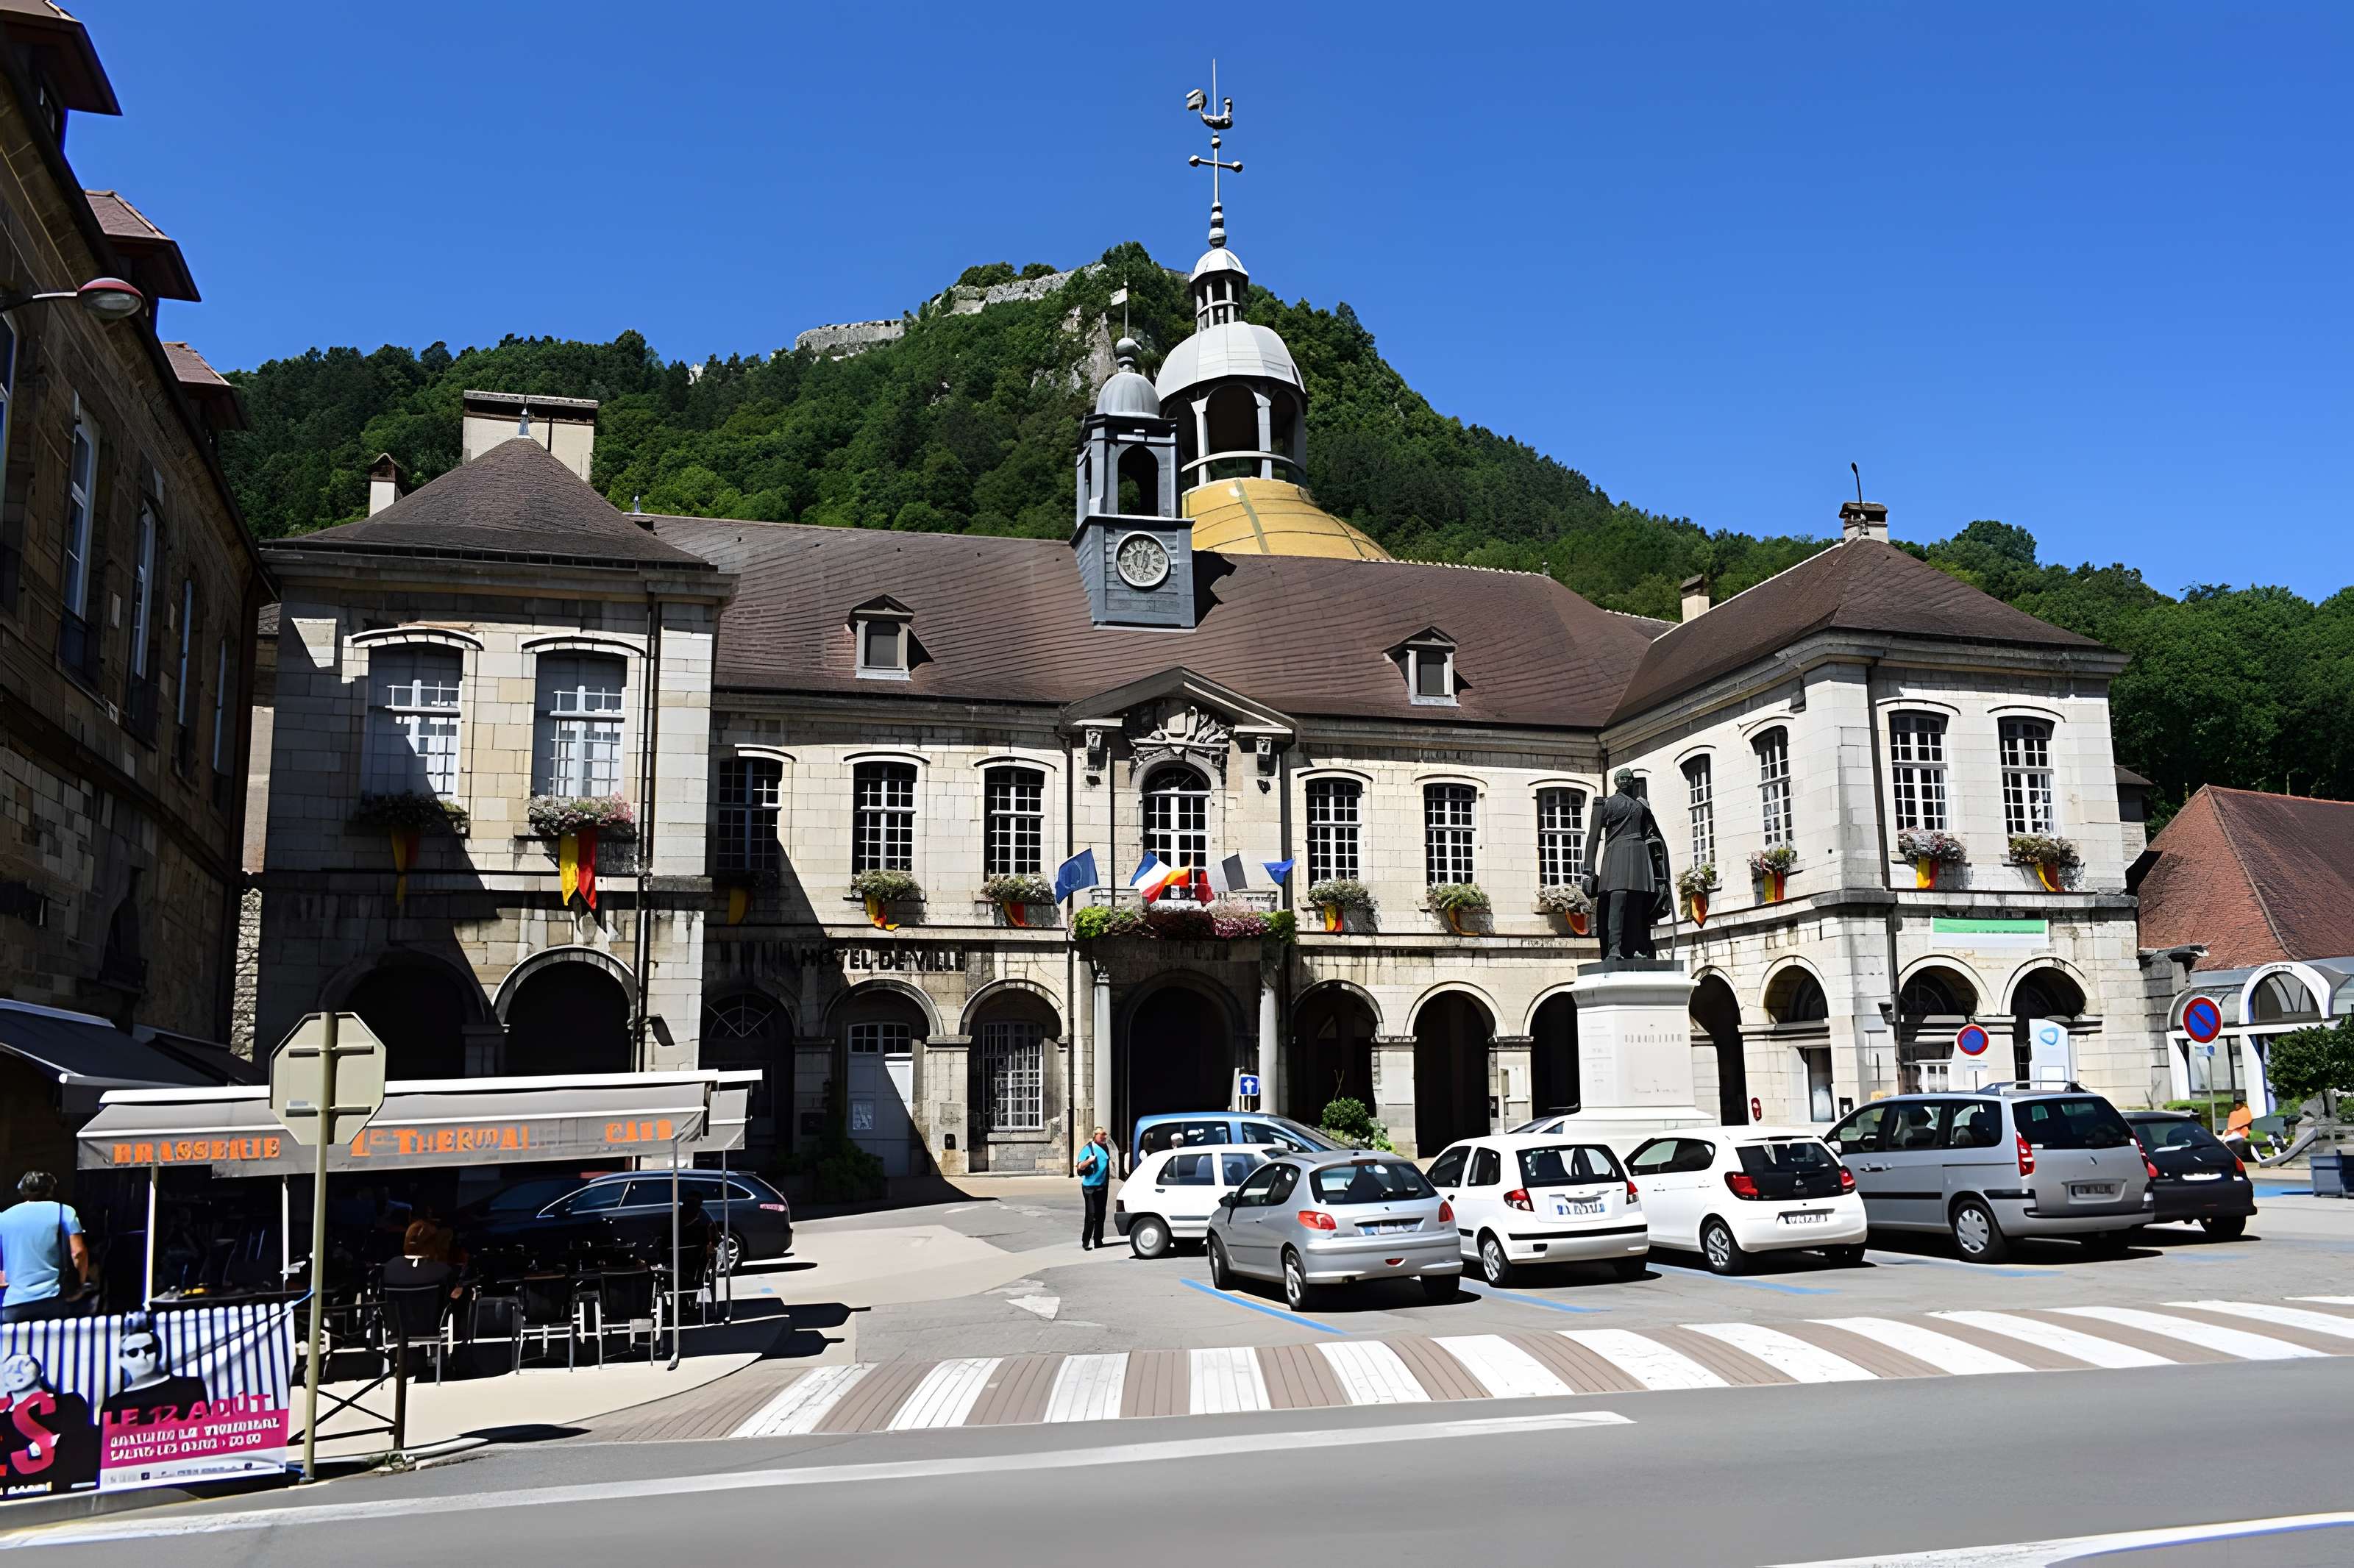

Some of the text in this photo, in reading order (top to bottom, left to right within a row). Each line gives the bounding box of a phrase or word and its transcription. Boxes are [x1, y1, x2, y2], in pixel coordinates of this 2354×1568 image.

[103, 1391, 271, 1426] LE 12 AOÛT
